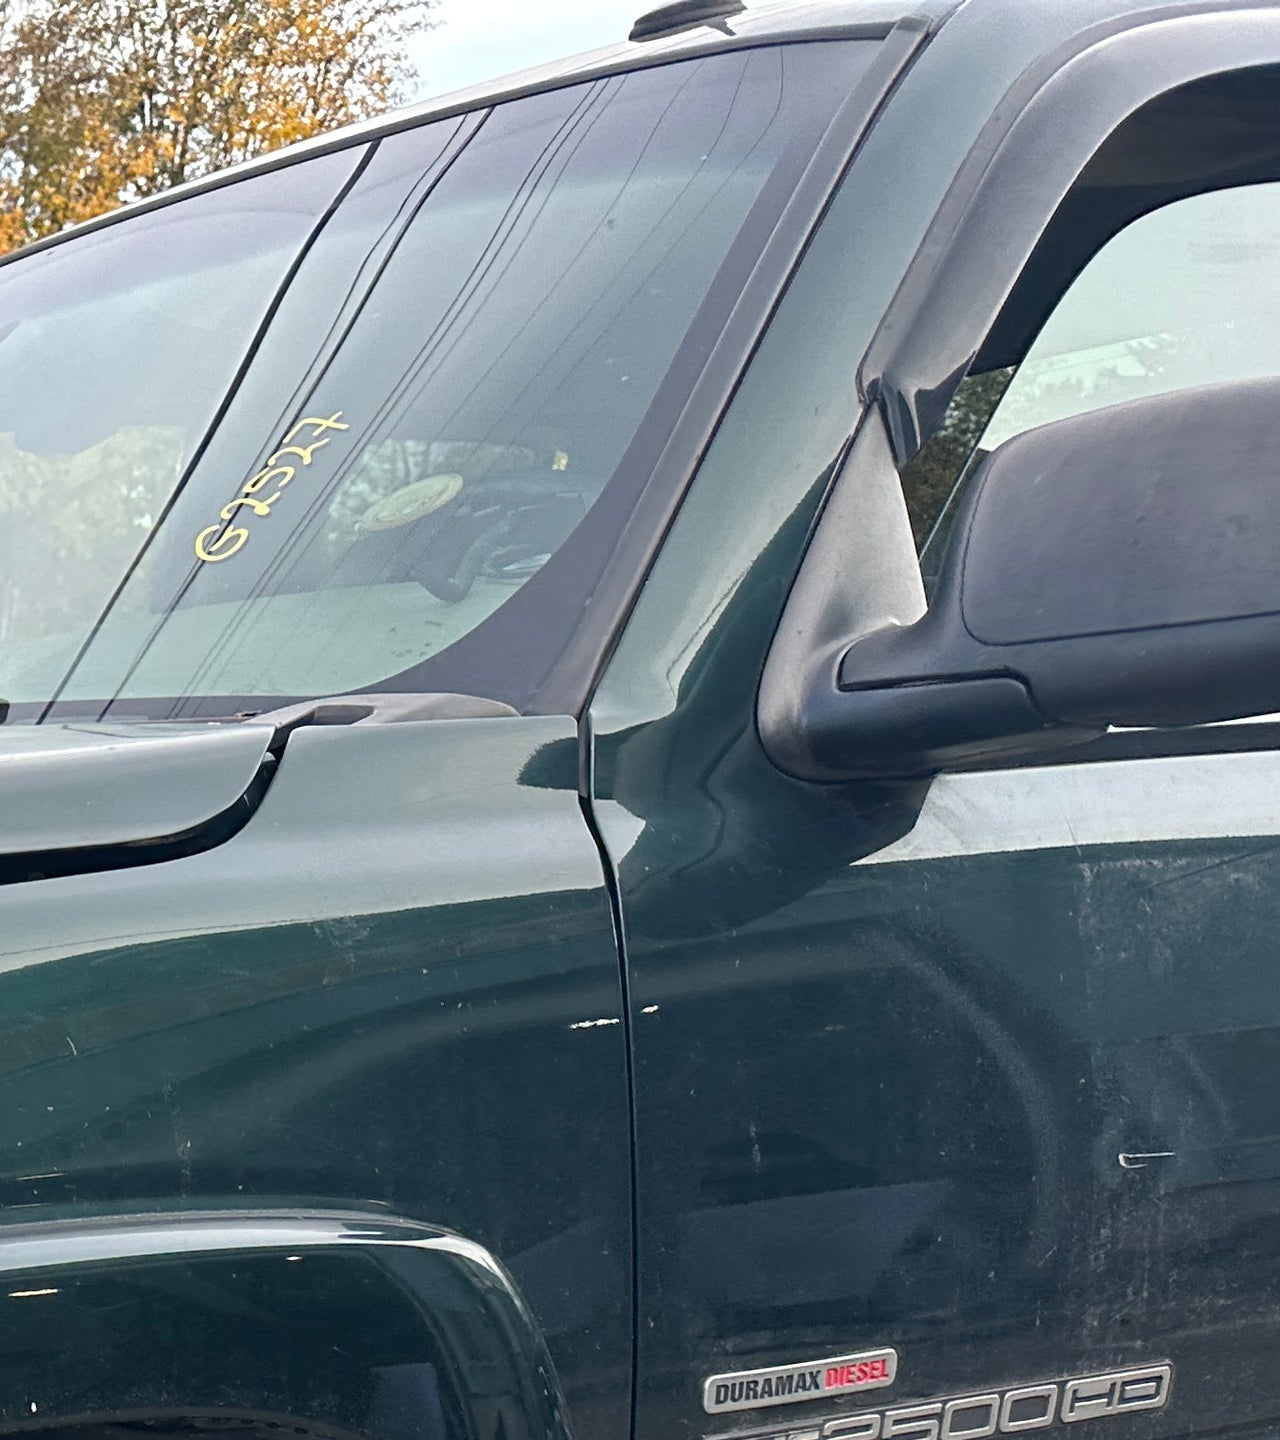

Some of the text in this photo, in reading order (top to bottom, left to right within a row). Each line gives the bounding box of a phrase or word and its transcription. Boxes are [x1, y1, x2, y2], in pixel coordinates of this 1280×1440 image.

[194, 411, 350, 562] G2527
[714, 1358, 890, 1405] DURAMAX DIESEL
